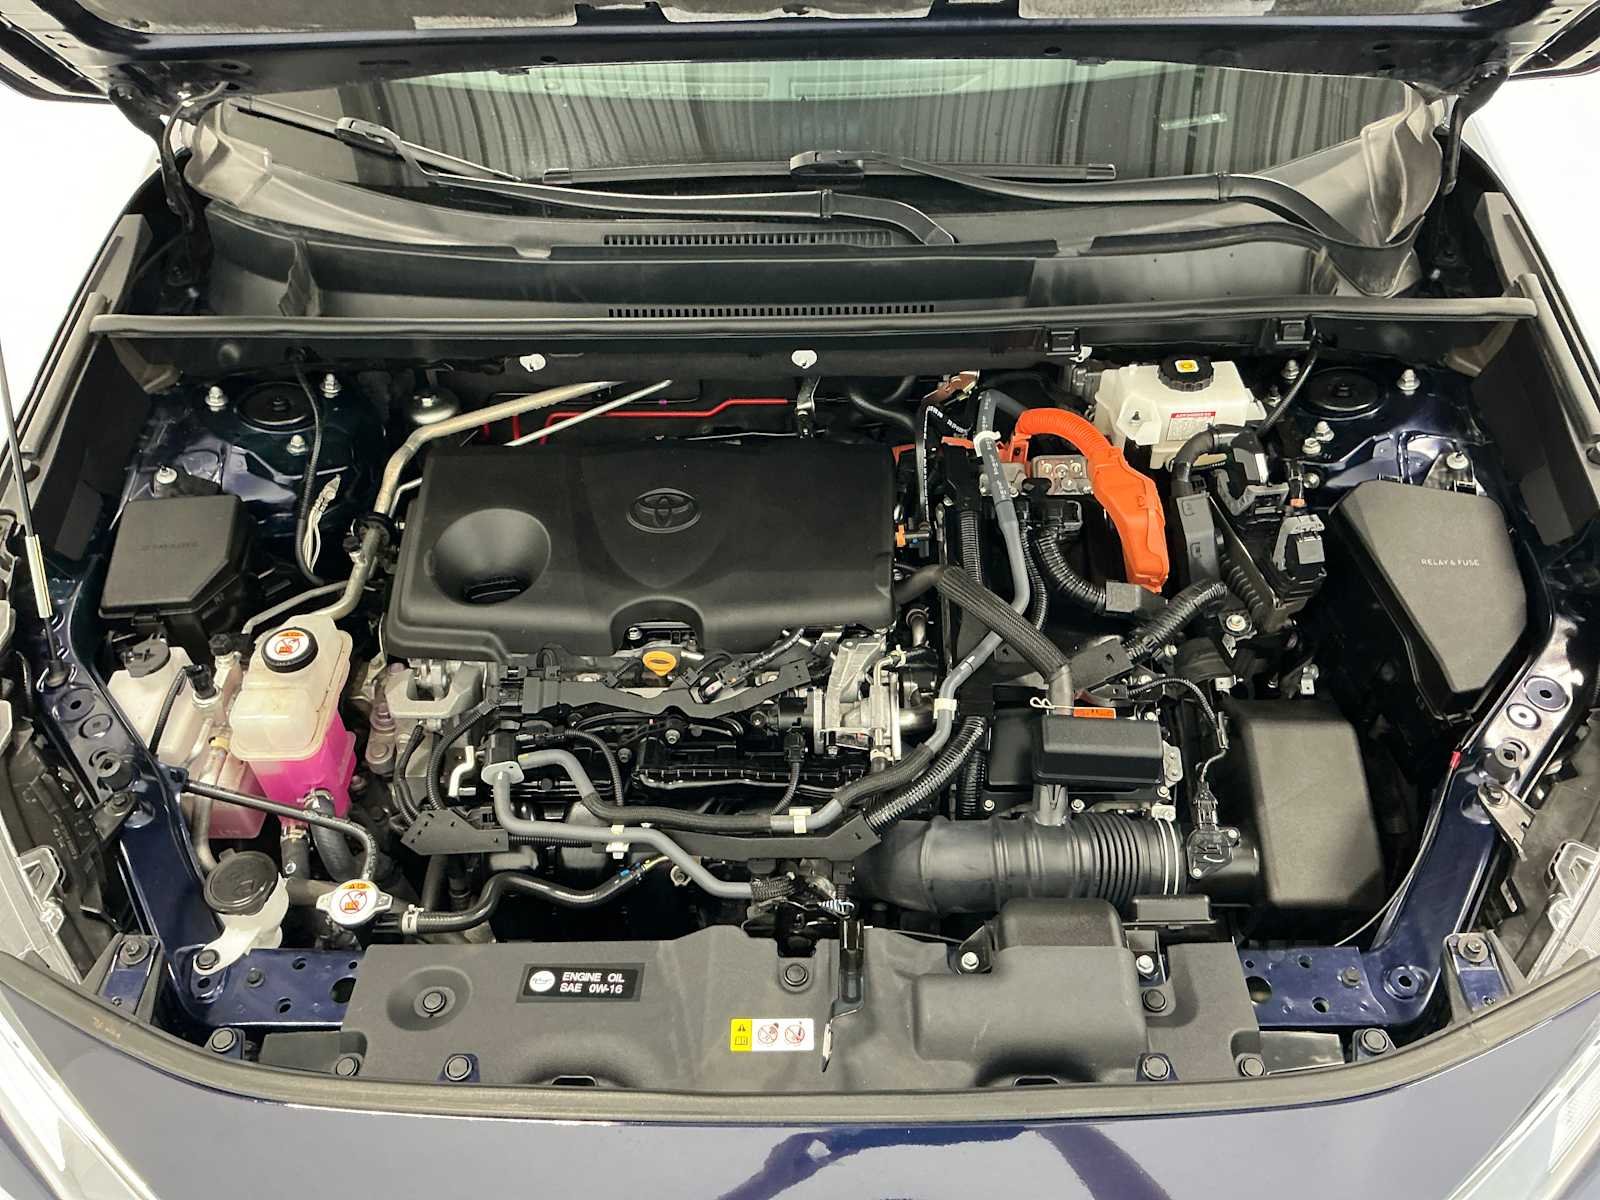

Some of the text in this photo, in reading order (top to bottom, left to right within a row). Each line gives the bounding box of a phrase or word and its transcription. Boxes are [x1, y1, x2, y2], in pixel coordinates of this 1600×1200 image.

[1420, 558, 1449, 567] RELAY
[1457, 559, 1480, 567] FUSE
[562, 971, 602, 982] ENGINE
[607, 973, 625, 983] OIL
[559, 982, 623, 994] SAE 0W-16
